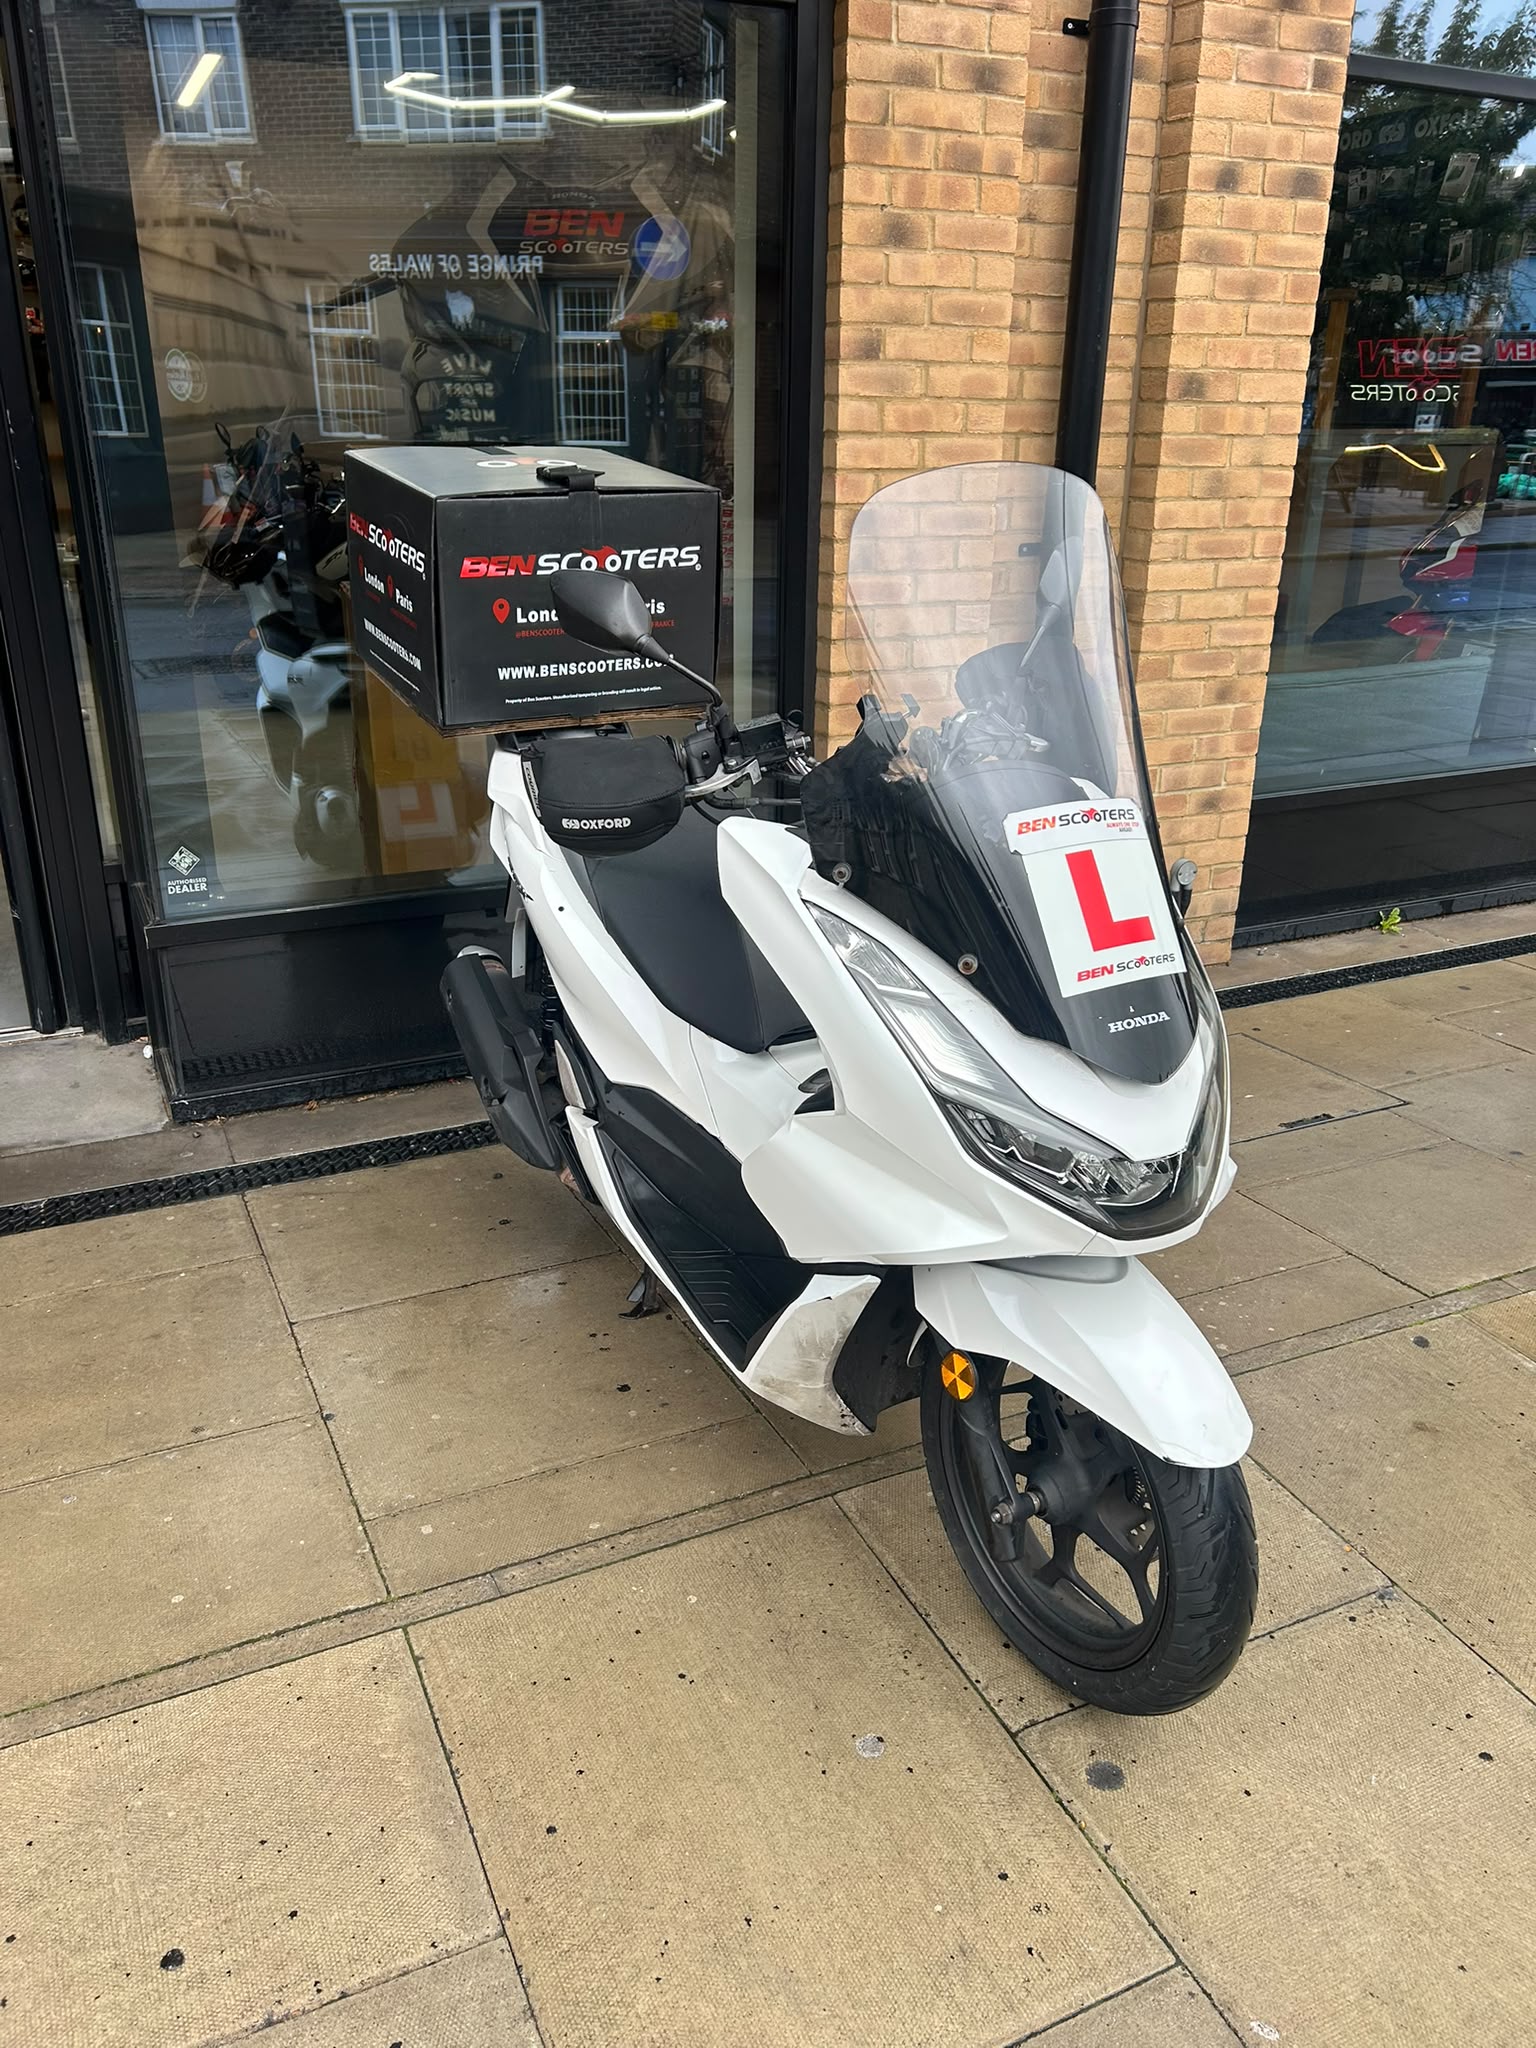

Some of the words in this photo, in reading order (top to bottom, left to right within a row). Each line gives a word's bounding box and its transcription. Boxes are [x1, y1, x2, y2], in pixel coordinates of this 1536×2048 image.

[522, 208, 625, 238] BEN
[364, 567, 385, 594] London
[395, 588, 414, 613] Paris
[580, 817, 632, 830] OXFORD
[1017, 815, 1056, 835] BEN
[167, 877, 207, 887] AUTHORISED
[167, 882, 208, 895] DEALER
[1065, 848, 1156, 953] L
[1077, 964, 1114, 983] BEN
[1107, 1011, 1171, 1034] HONDA
